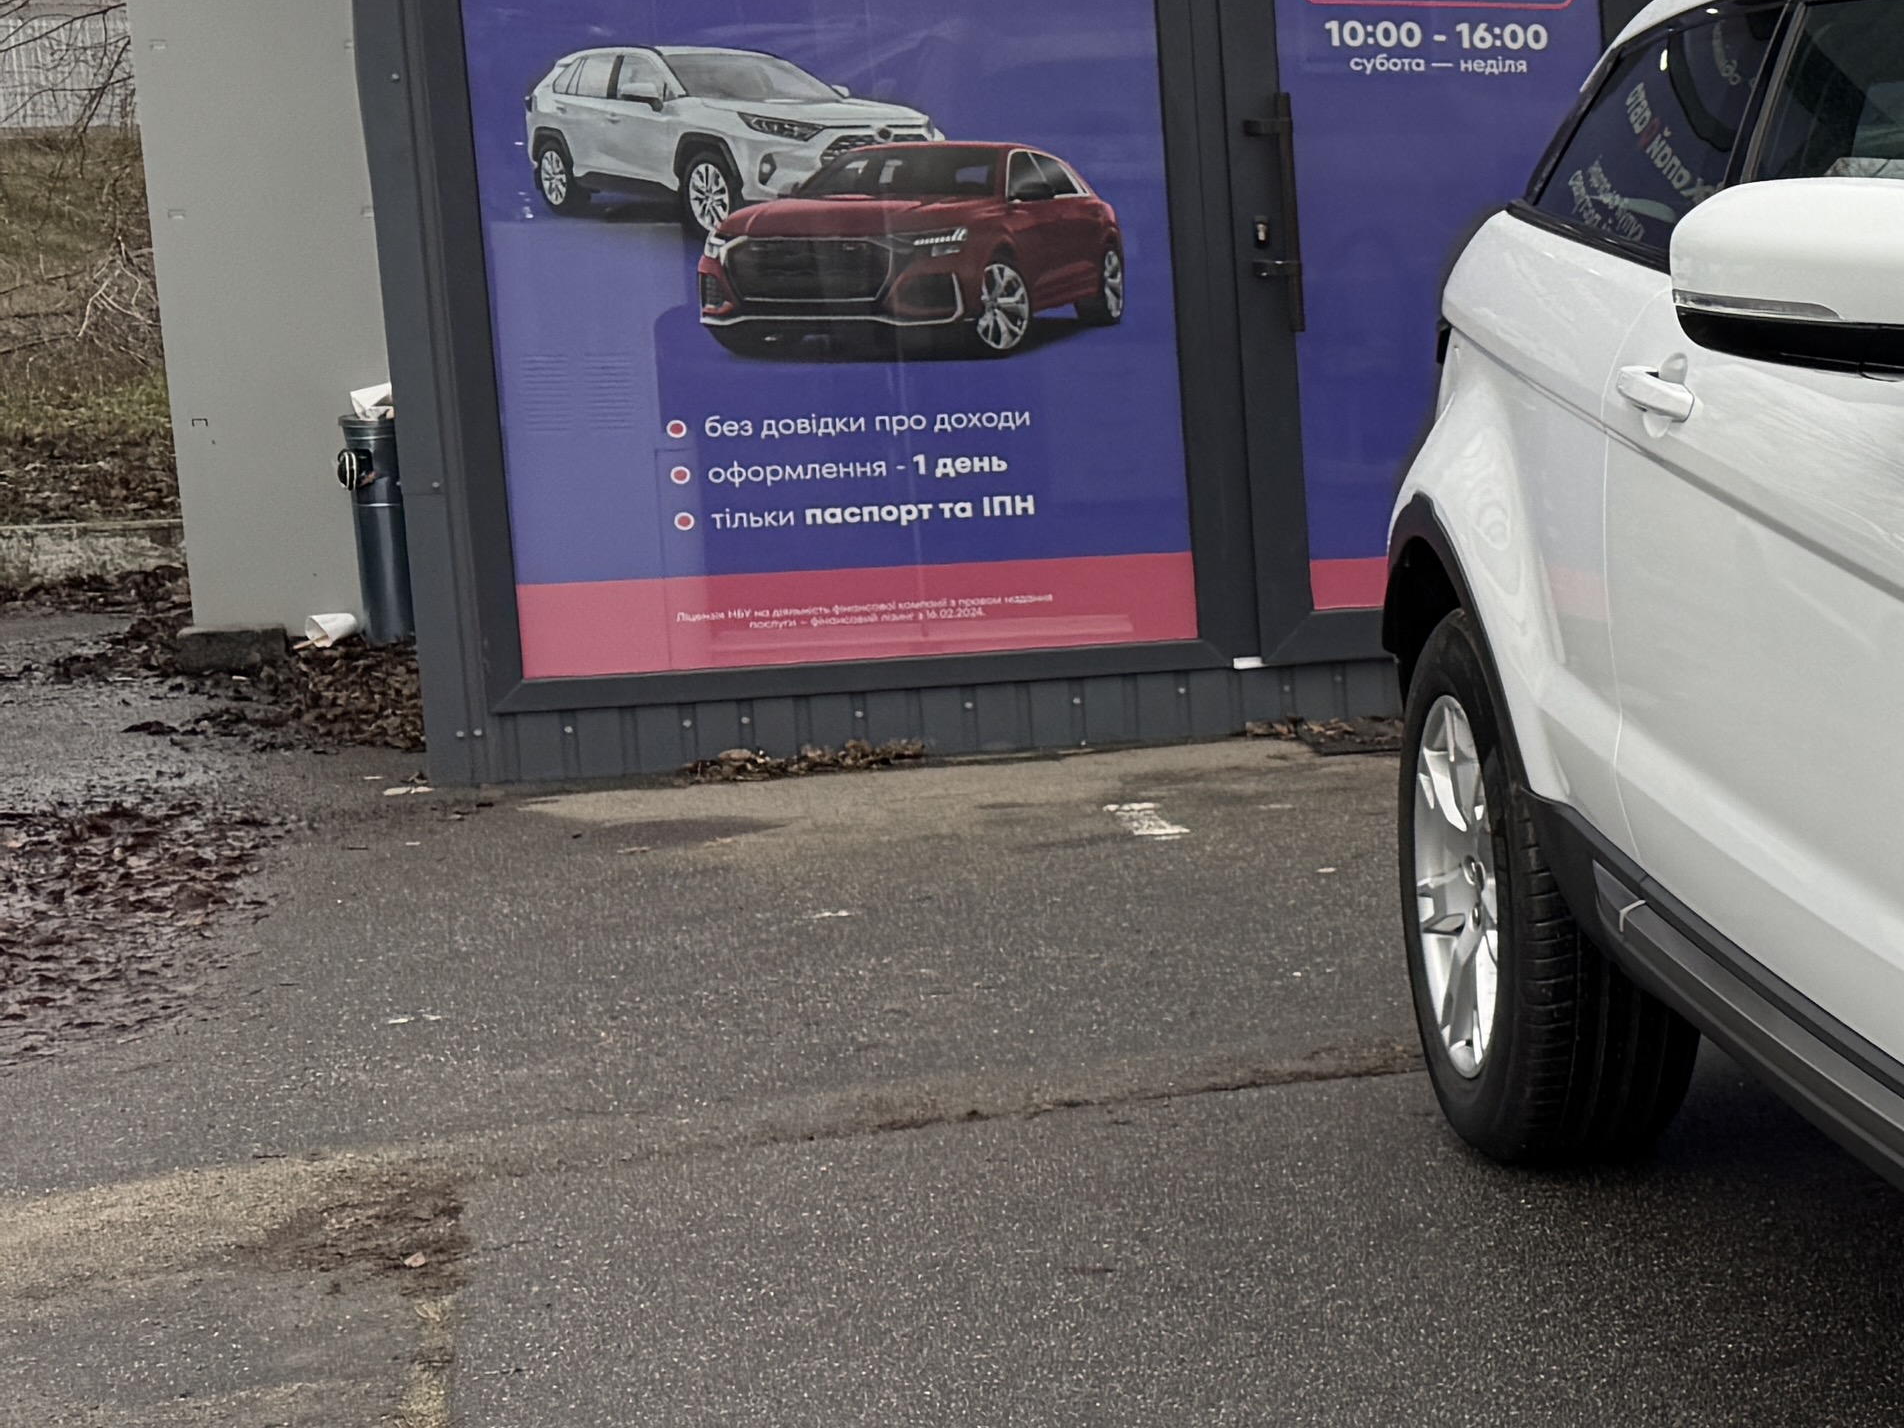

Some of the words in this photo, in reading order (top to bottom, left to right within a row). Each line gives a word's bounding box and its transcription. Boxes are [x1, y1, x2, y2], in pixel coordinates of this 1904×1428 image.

[1325, 20, 1422, 48] 10:00
[1456, 23, 1548, 50] 16:00
[1350, 54, 1426, 75] субота
[1460, 57, 1528, 75] неділя
[705, 415, 753, 437] без
[760, 413, 865, 439] довідки
[875, 414, 926, 435] про
[933, 410, 1031, 433] доходи
[708, 461, 887, 488] оформлення
[912, 454, 927, 476] 1
[935, 455, 1008, 478] день
[711, 509, 795, 530] тільки
[805, 501, 933, 526] паспорт
[939, 499, 973, 519] та
[983, 494, 1035, 517] ІПН
